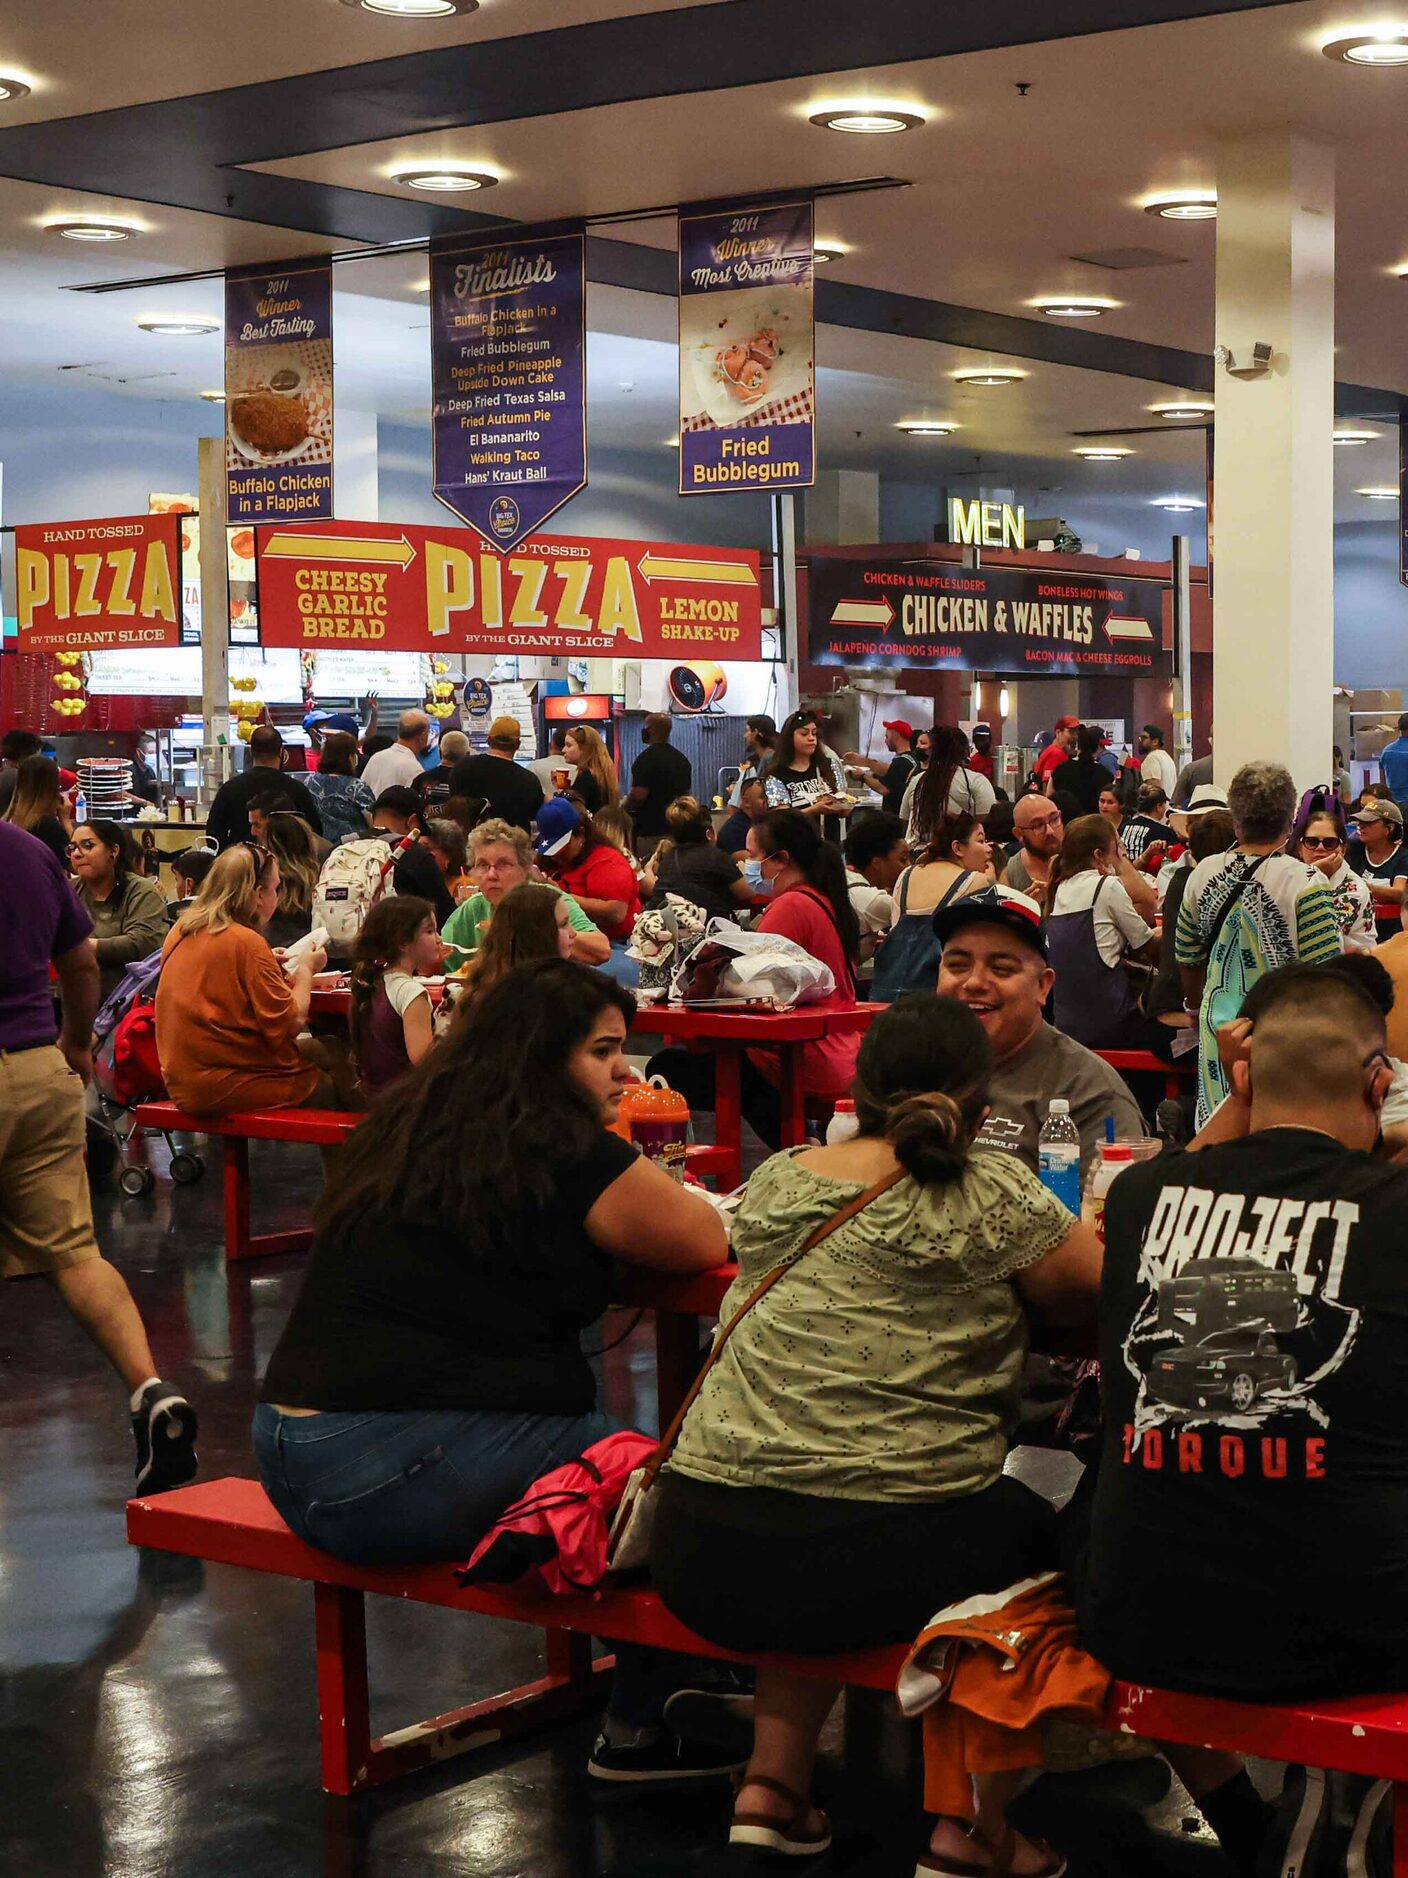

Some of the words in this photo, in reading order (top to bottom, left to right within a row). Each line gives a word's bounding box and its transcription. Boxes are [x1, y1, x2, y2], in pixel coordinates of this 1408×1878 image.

[716, 237, 776, 260] Winner
[454, 254, 557, 298] Finalists
[256, 298, 301, 318] Winner
[240, 324, 269, 341] Best
[270, 317, 316, 338] Tasting
[461, 345, 484, 358] Fried
[488, 340, 550, 355] Bubblegum
[448, 399, 472, 411] Deep
[475, 394, 500, 408] Fried
[504, 392, 535, 405] Texas
[537, 389, 566, 402] Salsa
[460, 415, 484, 429] Fried
[487, 412, 531, 426] Autumn
[534, 409, 551, 421] Pie
[722, 435, 770, 458] Fried
[470, 452, 511, 466] Walking
[515, 450, 540, 462] Taco
[693, 460, 800, 483] Bubblegum
[229, 477, 276, 495] Buffalo
[279, 474, 331, 491] Chicken
[44, 529, 86, 542] HAND
[90, 525, 144, 539] TOSSED
[948, 497, 1025, 549] MEN
[480, 541, 527, 553] HD
[530, 544, 591, 557] TOSSED
[17, 540, 176, 630] PIZZA
[295, 569, 388, 593] CHEESY
[425, 540, 644, 643] PIZZA
[1038, 585, 1079, 598] BONELESS
[1080, 588, 1097, 599] HOT
[1097, 589, 1124, 601] WINGS
[297, 593, 388, 616] GARLIC
[660, 597, 739, 622] LEMON
[303, 617, 386, 639] BREAD
[902, 594, 988, 636] CHICKEN
[993, 600, 1008, 633] &
[1011, 601, 1094, 645] WAFFLES
[30, 636, 43, 645] BY
[44, 635, 65, 644] THE
[66, 631, 116, 644] GIANT
[118, 629, 165, 642] SLICE
[466, 634, 480, 643] BY
[481, 635, 506, 644] THE
[507, 635, 563, 647] GIANT
[565, 636, 614, 648] SLICE
[661, 625, 741, 642] SHAKE-UP
[829, 639, 878, 655] JALAPEÑO
[879, 643, 926, 656] CORNDOG
[927, 645, 962, 657] SHRIMP
[1025, 649, 1055, 662] BACON
[1056, 651, 1073, 663] MAC
[1076, 653, 1082, 663] &
[1082, 653, 1112, 665] CHEESE
[1114, 654, 1152, 666] EGGROLLS
[973, 1137, 1019, 1150] HEVROLET
[1140, 1185, 1360, 1299] PROJECT
[1122, 1424, 1327, 1479] TORQUE
